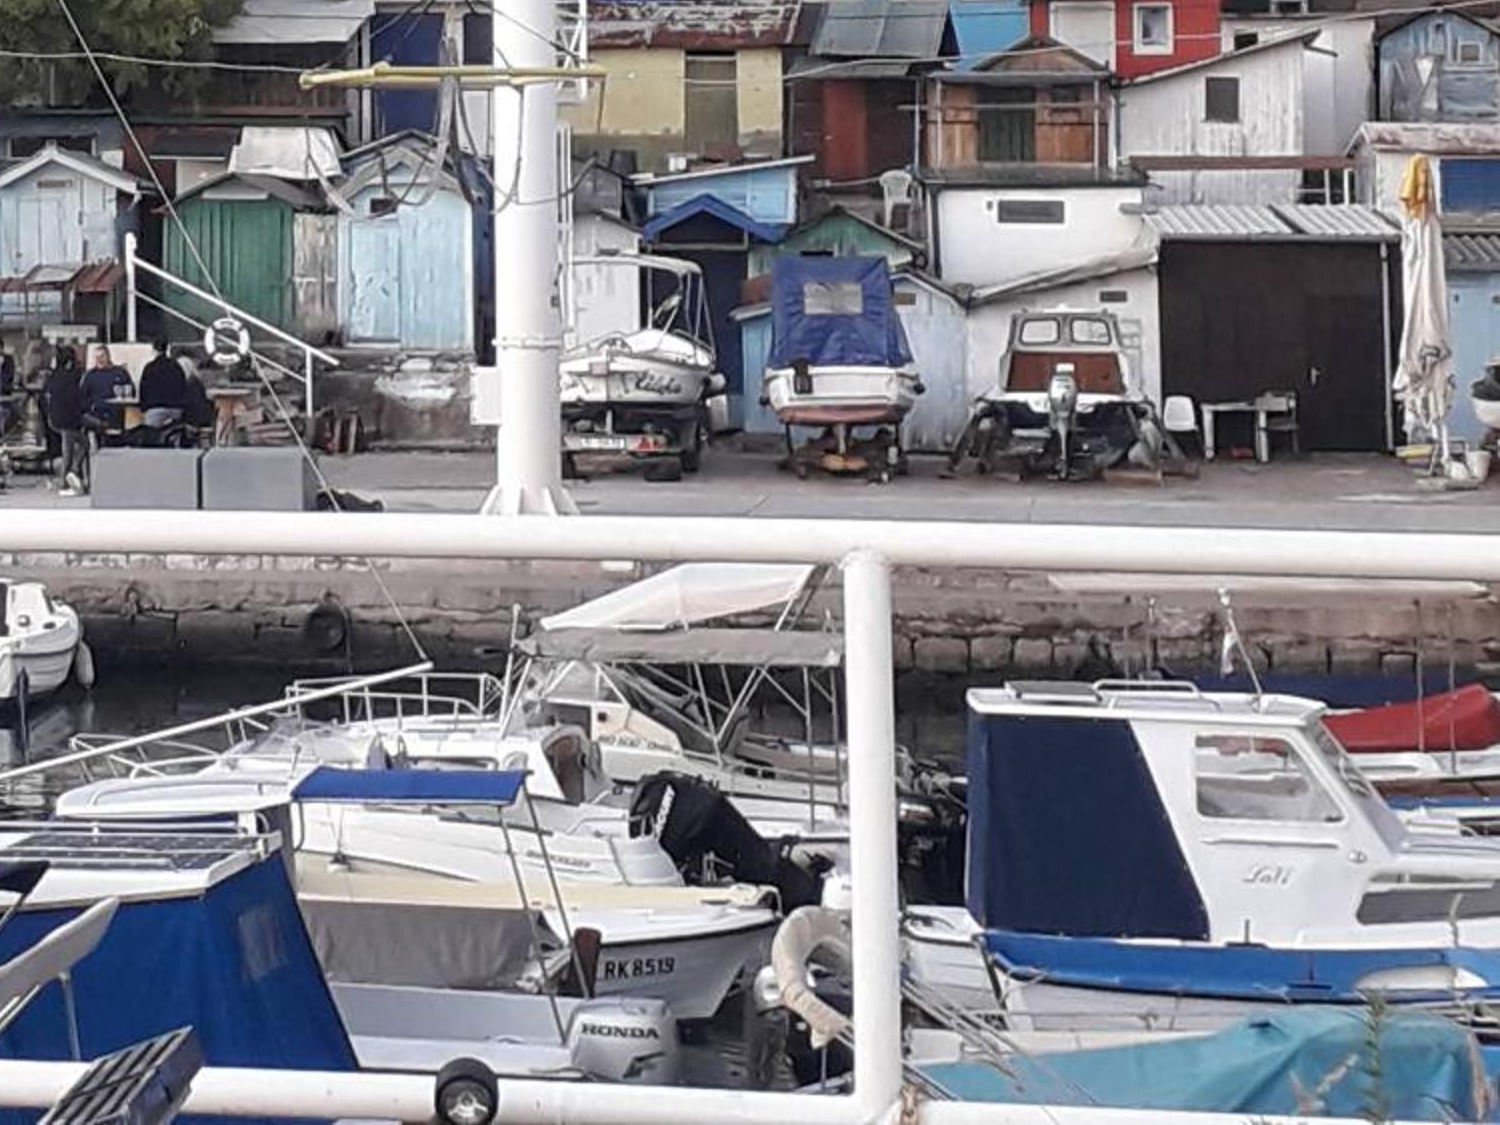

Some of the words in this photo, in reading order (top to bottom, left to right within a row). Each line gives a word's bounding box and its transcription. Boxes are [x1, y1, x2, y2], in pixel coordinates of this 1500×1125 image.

[605, 961, 629, 979] RK
[632, 957, 676, 977] 8519
[581, 1023, 660, 1040] HONDA
